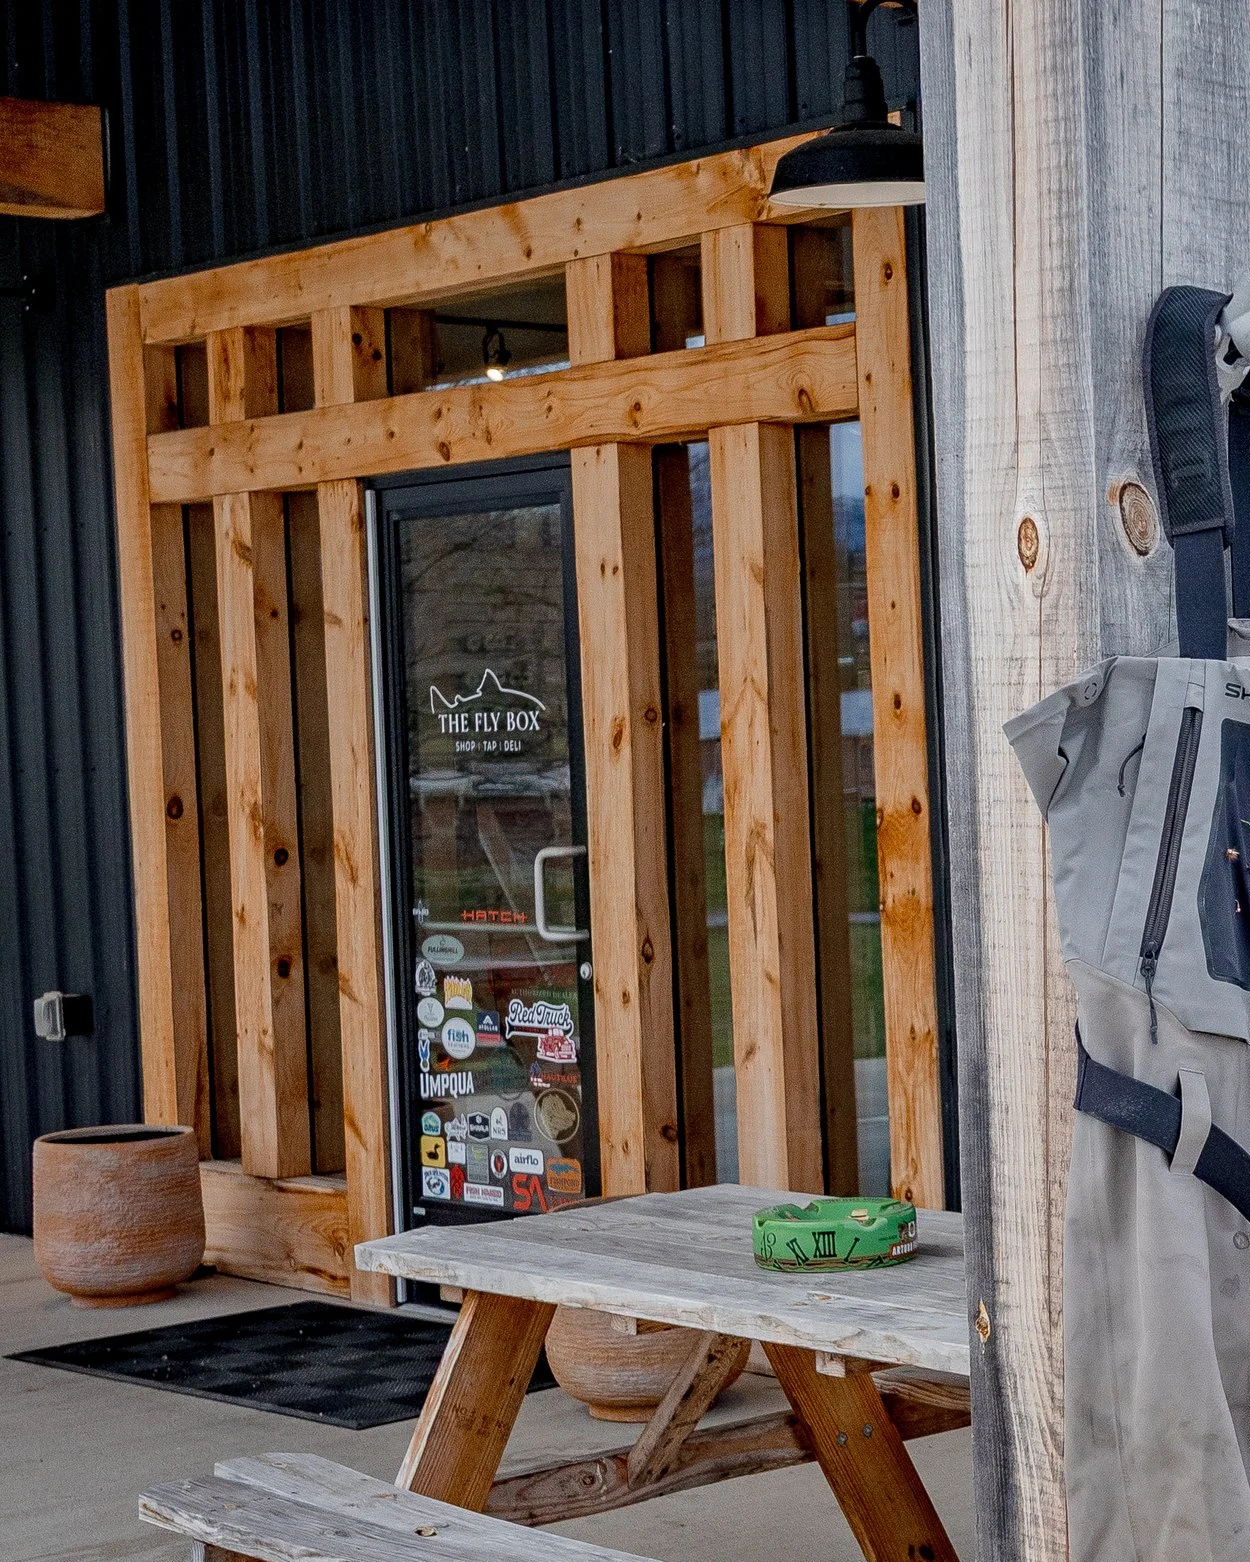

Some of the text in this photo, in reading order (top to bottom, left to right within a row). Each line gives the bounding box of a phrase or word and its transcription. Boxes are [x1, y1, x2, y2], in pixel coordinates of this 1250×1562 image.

[438, 710, 541, 733] THE FLY BOX
[455, 740, 521, 752] SHOP TAP DELI
[461, 910, 527, 924] HATCH
[509, 1001, 573, 1028] Red Truck
[447, 1028, 470, 1043] fish
[420, 1071, 475, 1099] UMPQUA
[514, 1153, 539, 1166] airflo
[812, 1231, 837, 1258] XIII
